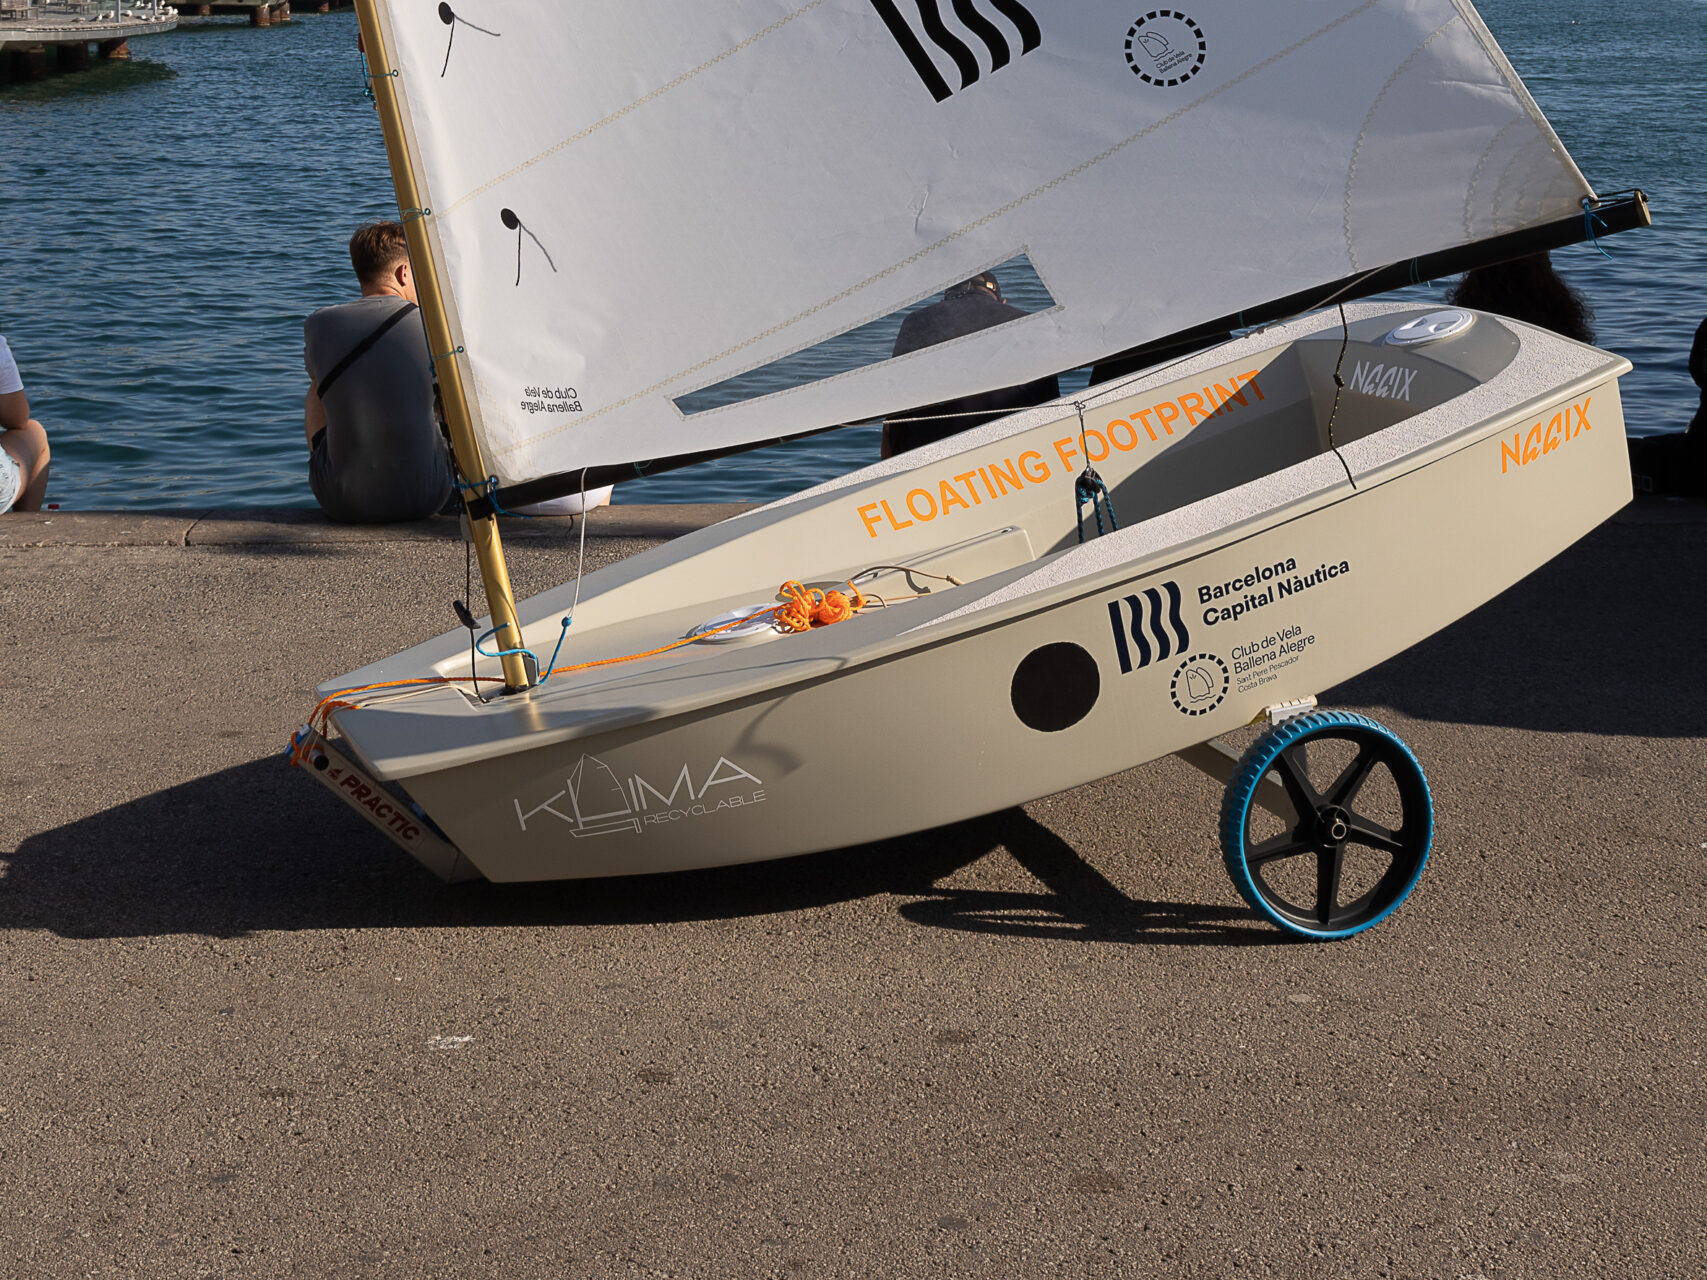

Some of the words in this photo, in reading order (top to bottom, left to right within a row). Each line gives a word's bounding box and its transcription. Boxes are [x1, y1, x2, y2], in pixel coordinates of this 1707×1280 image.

[857, 449, 1052, 538] FLOATING
[1052, 368, 1266, 474] FOOTPRINT
[1197, 557, 1297, 604] Barcelona
[1202, 585, 1275, 626] Capital
[1276, 560, 1350, 599] Nàutica
[1231, 641, 1260, 660] Club
[1261, 635, 1277, 650] de
[1276, 624, 1302, 642] Vela
[1233, 651, 1277, 674] Ballena
[1278, 634, 1316, 658] Alegre
[1236, 674, 1252, 685] Sant
[1252, 667, 1269, 679] Pere
[1269, 654, 1300, 673] Pescador
[1237, 681, 1258, 694] Costa
[1258, 673, 1278, 686] Brava
[339, 774, 420, 841] PRACTIC
[644, 789, 767, 826] RECYCLABLE
